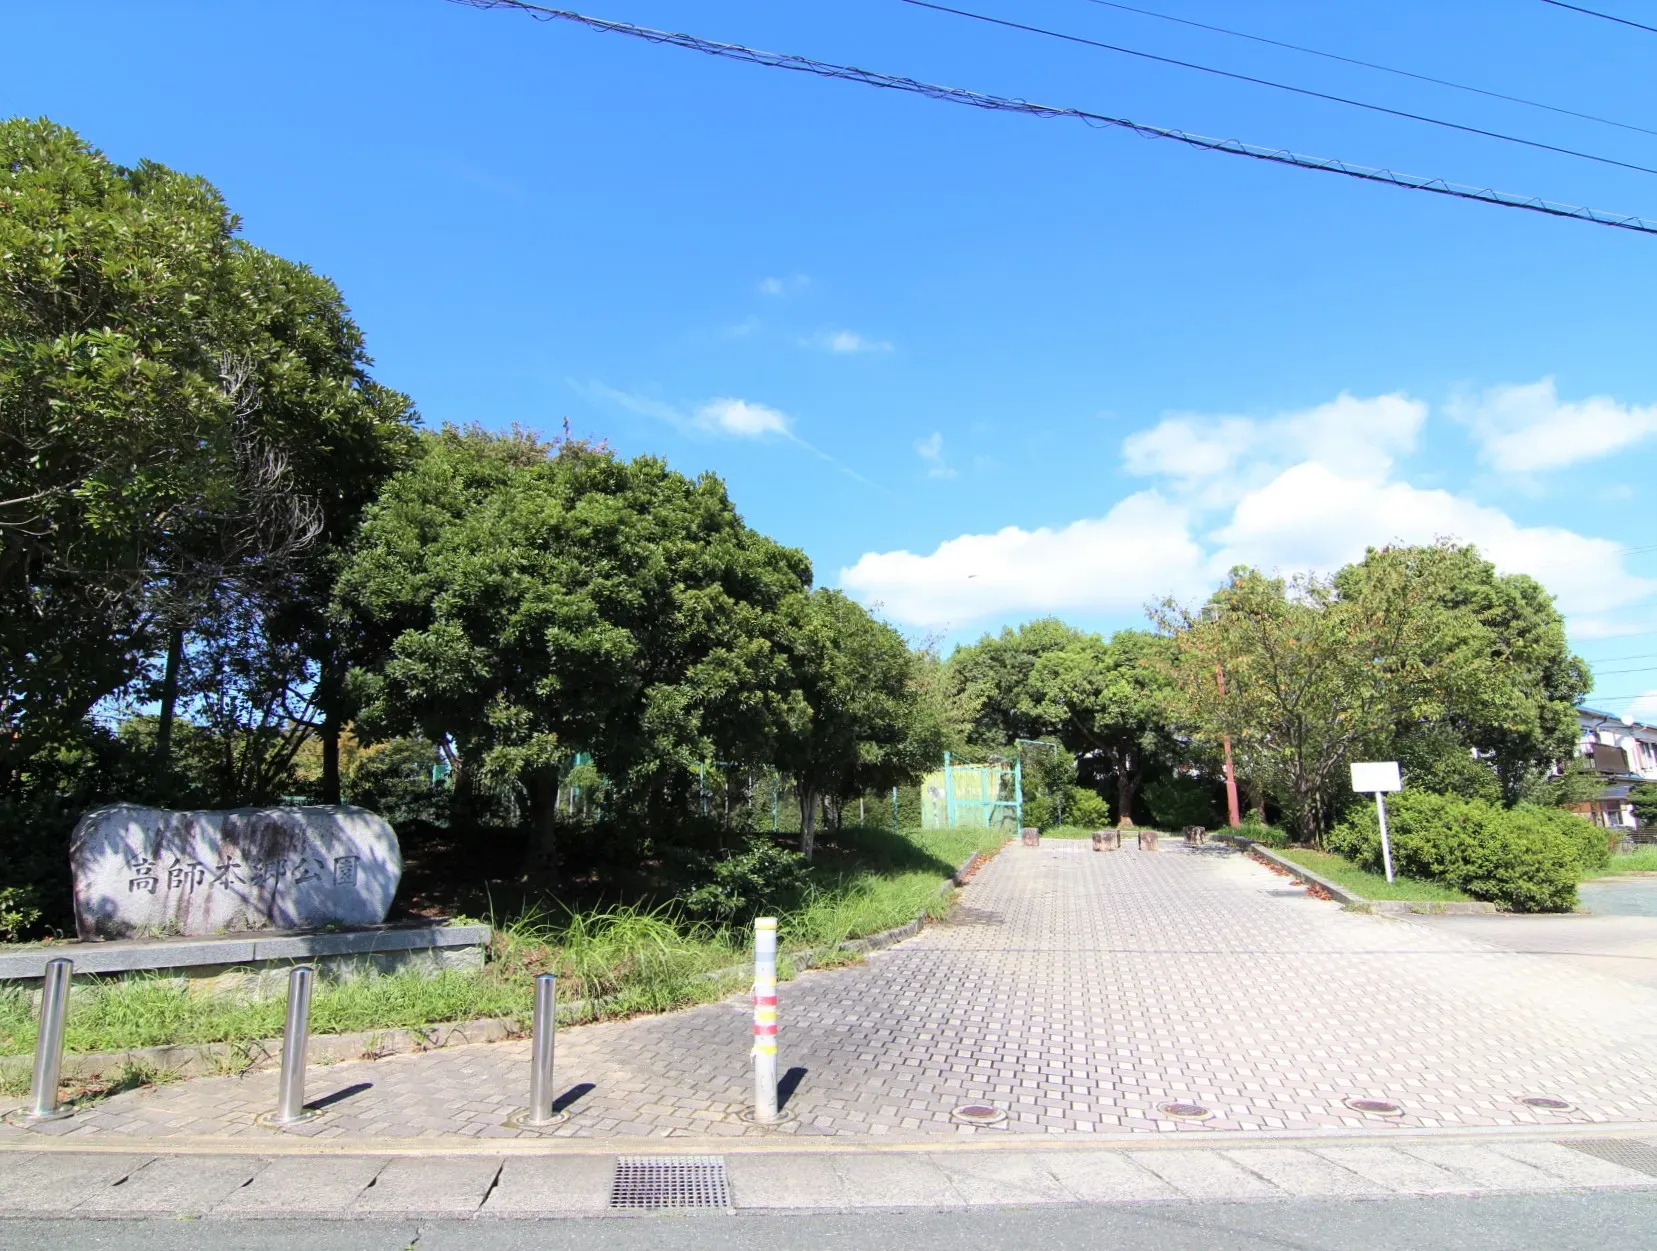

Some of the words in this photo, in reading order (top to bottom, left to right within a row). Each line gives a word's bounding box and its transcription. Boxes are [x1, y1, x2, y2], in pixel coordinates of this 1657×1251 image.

[127, 855, 361, 895] 高師本郷公園
